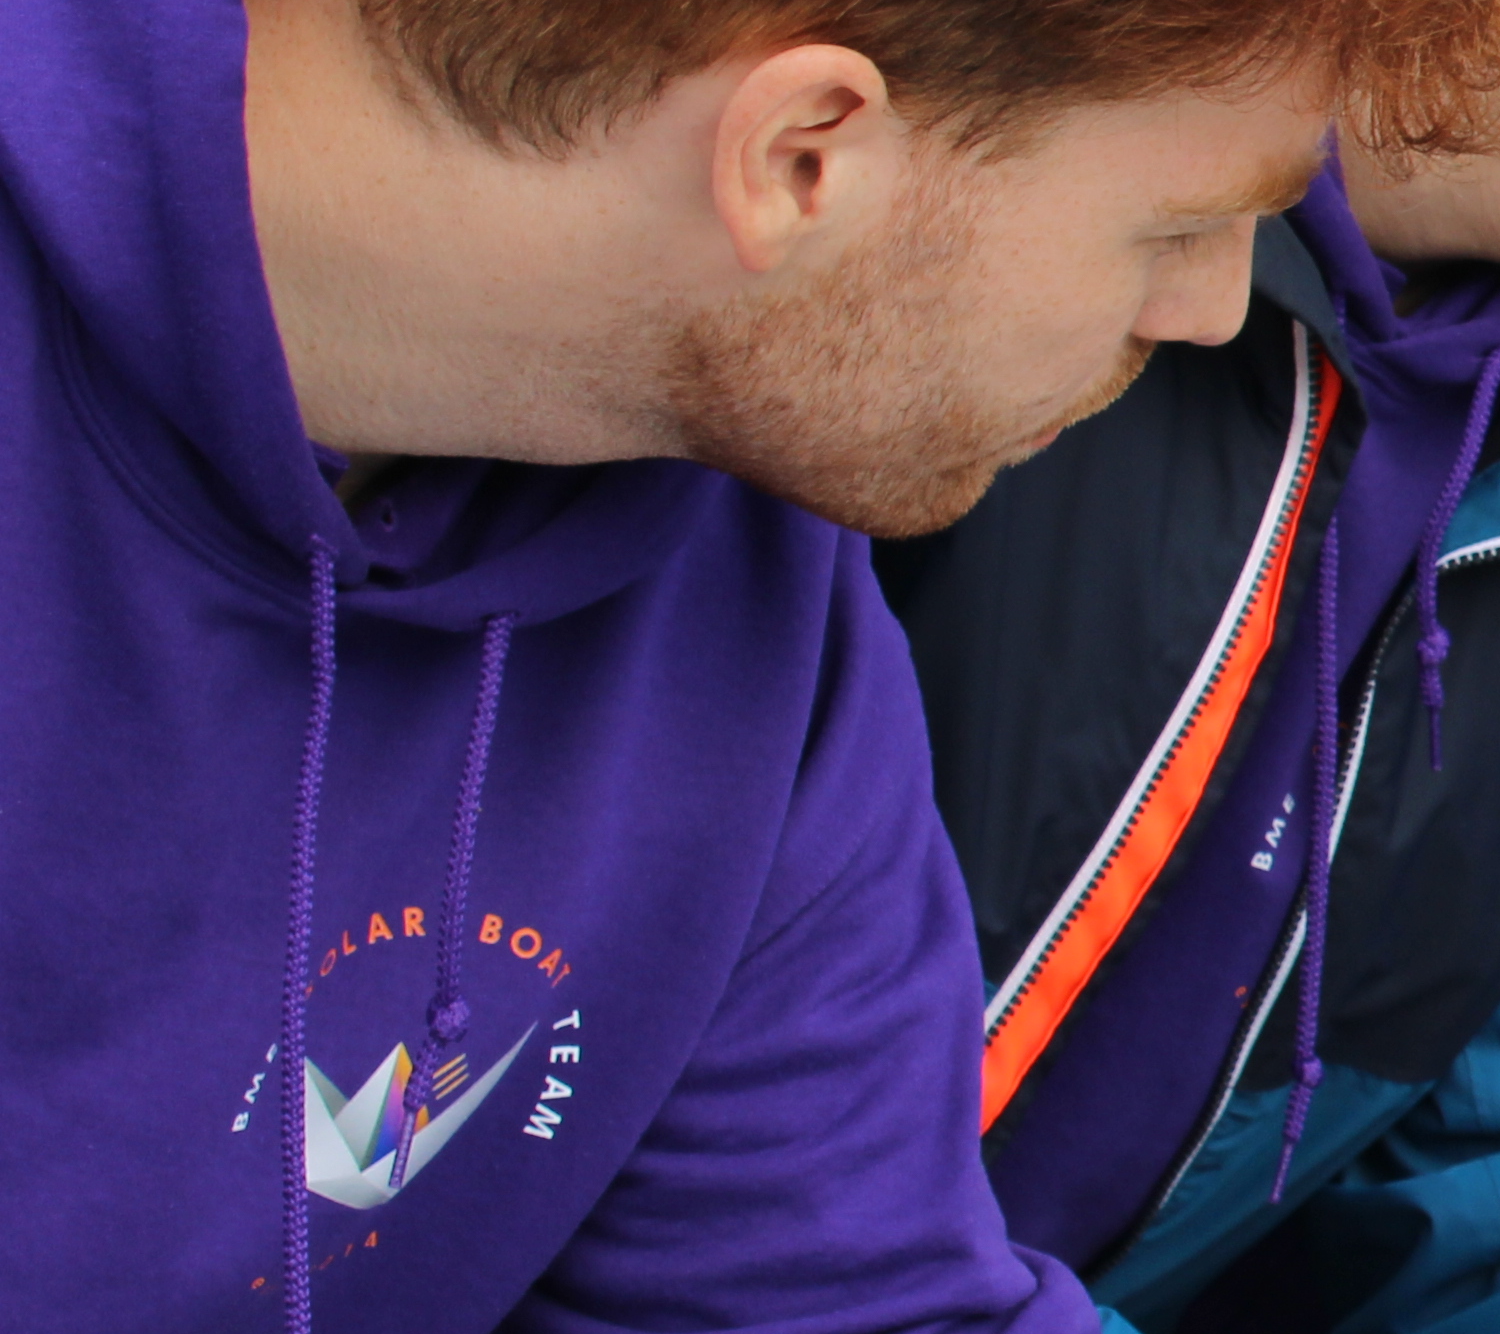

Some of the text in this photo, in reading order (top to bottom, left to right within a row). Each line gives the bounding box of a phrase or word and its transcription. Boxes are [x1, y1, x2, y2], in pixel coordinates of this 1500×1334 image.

[1250, 792, 1296, 872] BME
[478, 913, 572, 989] BOAT
[523, 1008, 581, 1141] TEAM
